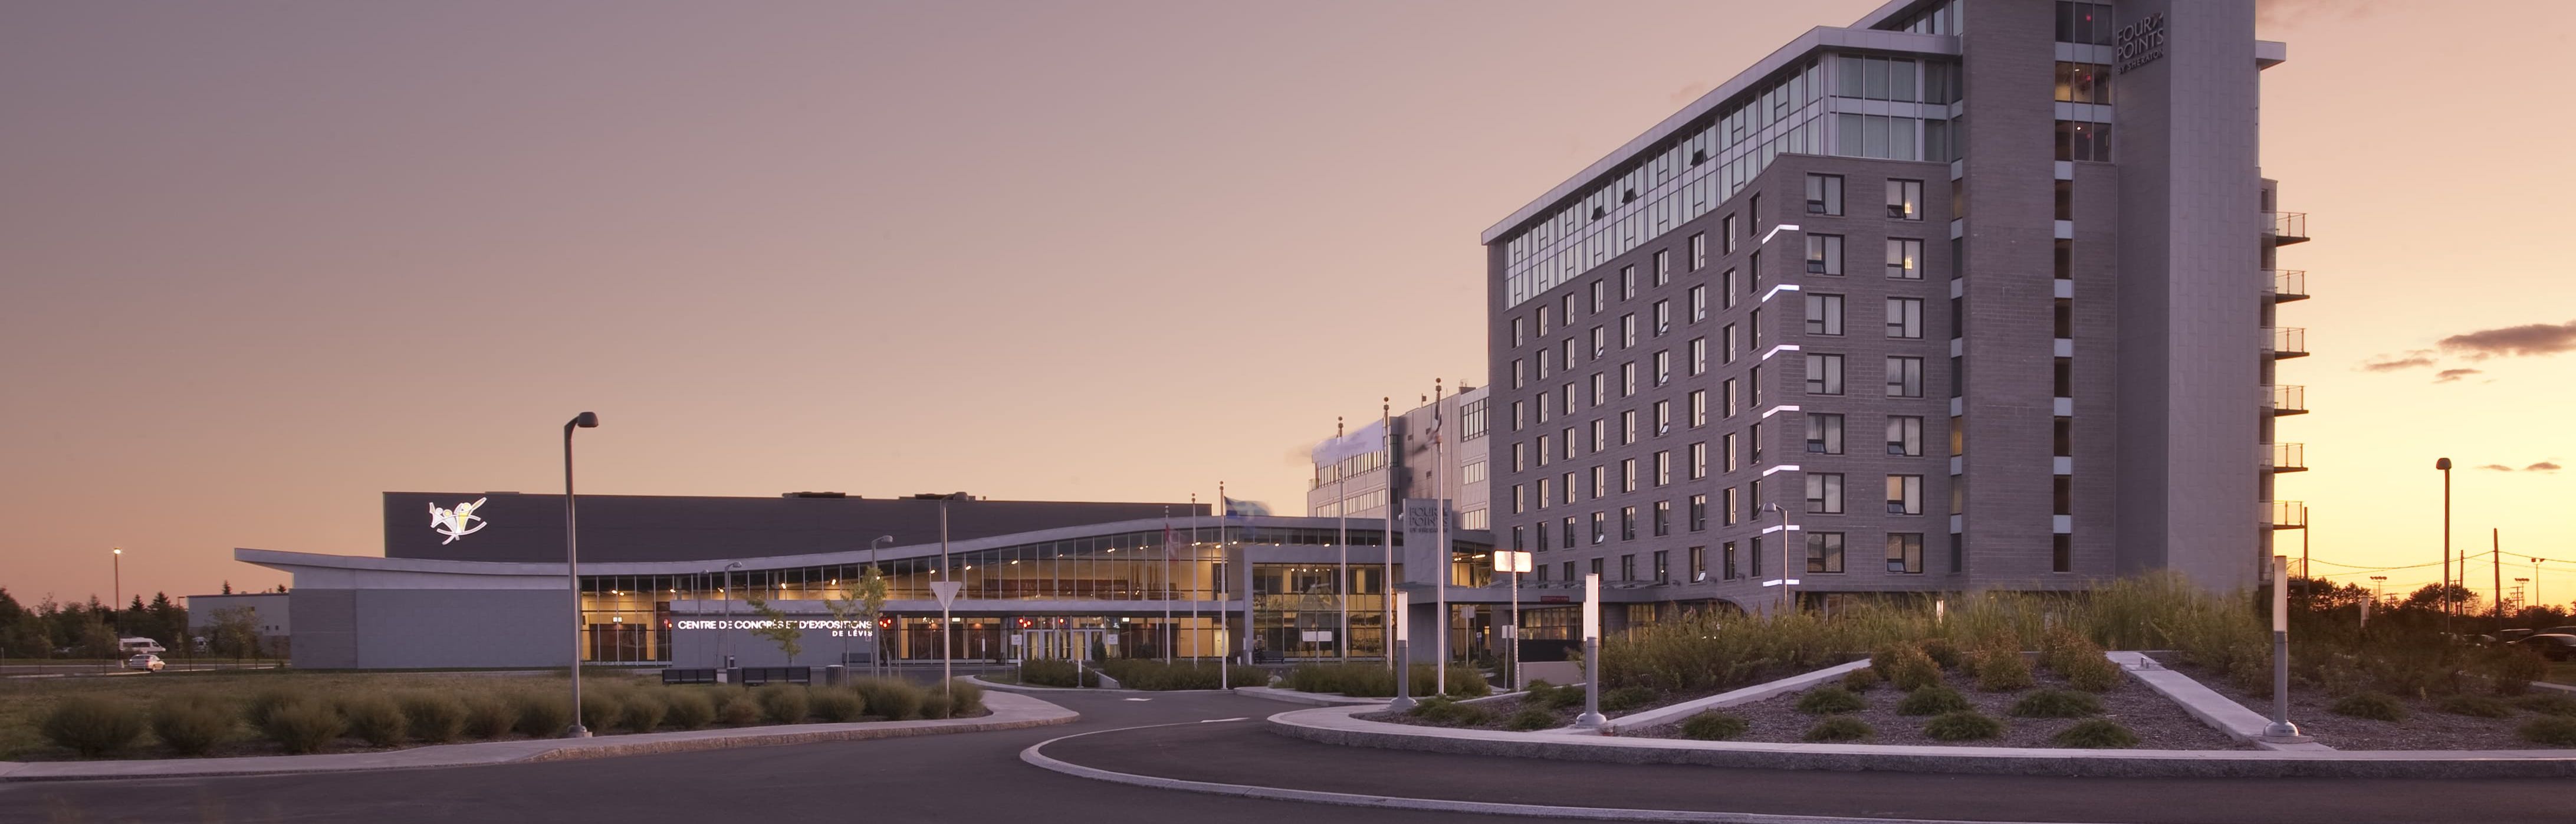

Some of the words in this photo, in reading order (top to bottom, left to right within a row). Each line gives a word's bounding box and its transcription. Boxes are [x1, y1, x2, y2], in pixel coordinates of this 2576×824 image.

[2117, 17, 2151, 46] FOUR
[2117, 28, 2164, 63] POINTS
[2128, 48, 2164, 70] SHERATON
[1409, 517, 1448, 527] POINS
[678, 620, 717, 629] CENTRE
[719, 620, 732, 629] DE
